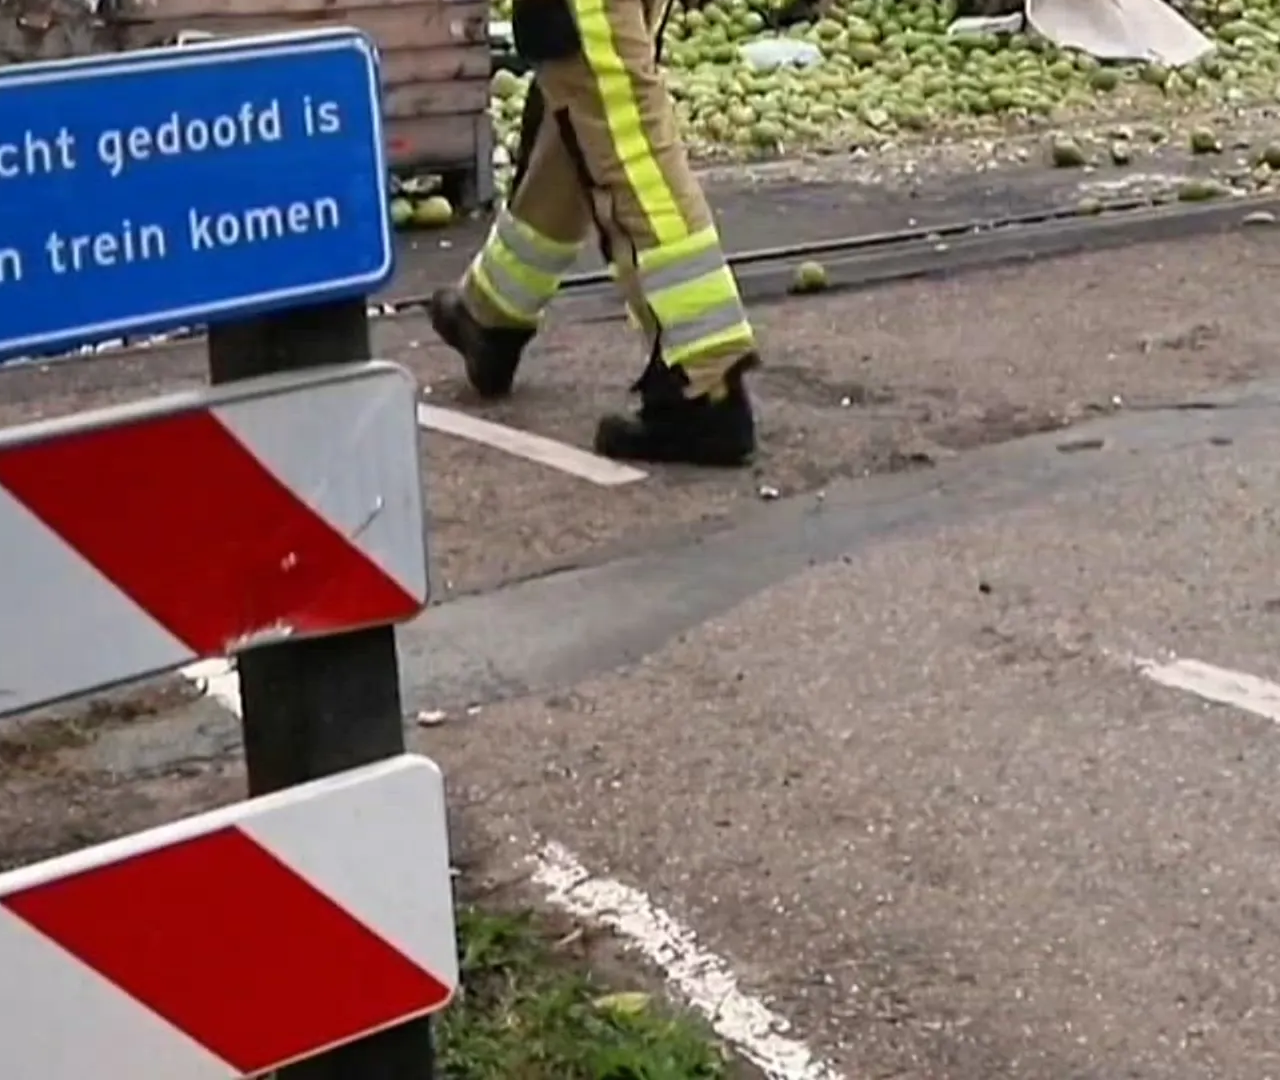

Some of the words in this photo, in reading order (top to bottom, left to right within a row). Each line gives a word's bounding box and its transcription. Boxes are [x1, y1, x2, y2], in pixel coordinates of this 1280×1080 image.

[98, 98, 282, 177] gedoofd
[303, 96, 341, 135] is
[46, 222, 166, 274] trein
[188, 196, 340, 251] komen
